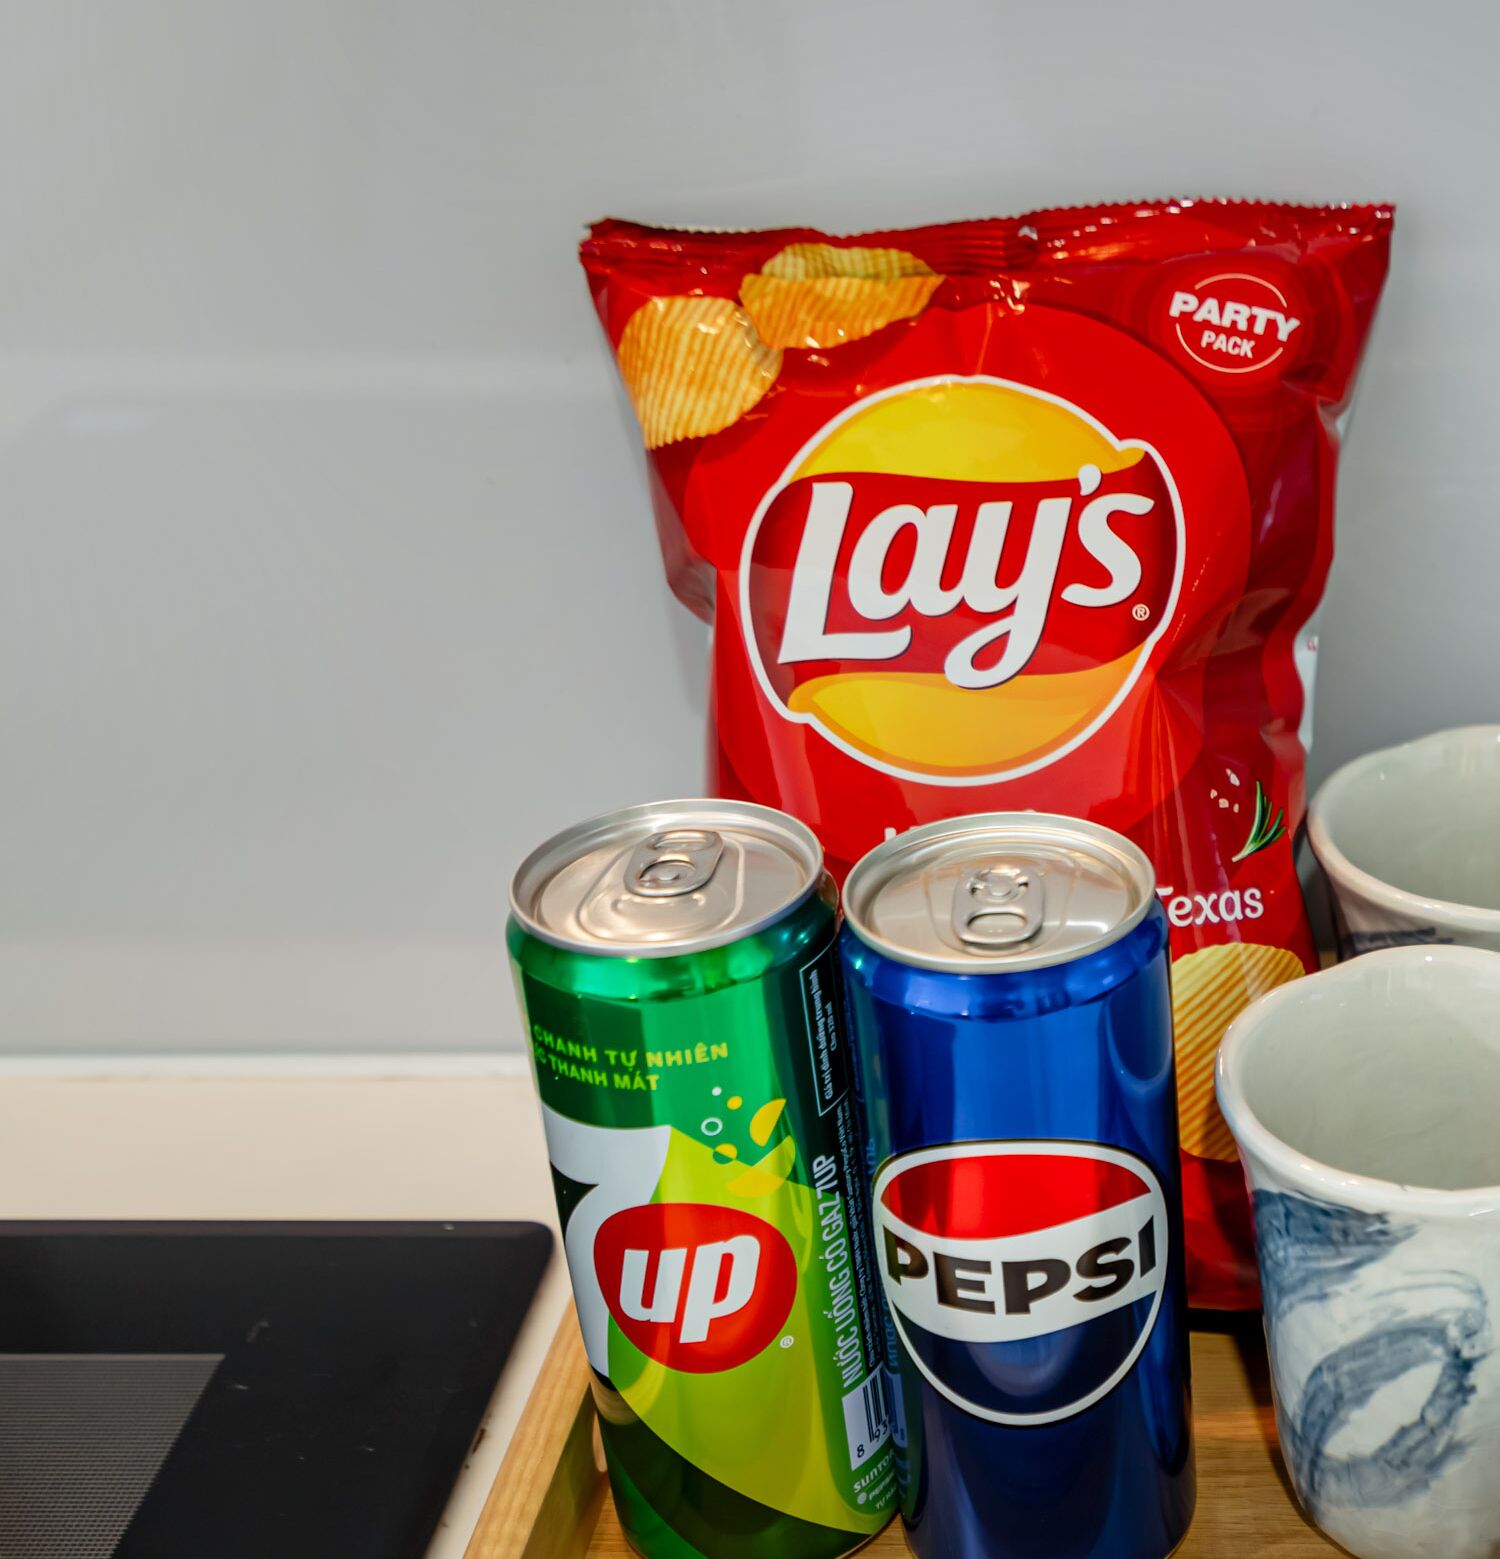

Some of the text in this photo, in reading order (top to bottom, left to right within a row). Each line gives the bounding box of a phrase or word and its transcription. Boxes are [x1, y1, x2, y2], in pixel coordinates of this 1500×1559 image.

[1169, 291, 1301, 342] PARTY
[1201, 330, 1256, 359] PACK
[777, 463, 1155, 689] Lay's
[534, 1024, 598, 1063] CHANH
[604, 1050, 638, 1071] TỰ
[646, 1042, 728, 1068] NHIÊN
[548, 1054, 660, 1091] THANH MÁT
[812, 1154, 864, 1387] NƯỚC UỐNG CÓ GAZ 7UP
[882, 1214, 1157, 1316] PEPSI
[856, 1444, 866, 1458] 8
